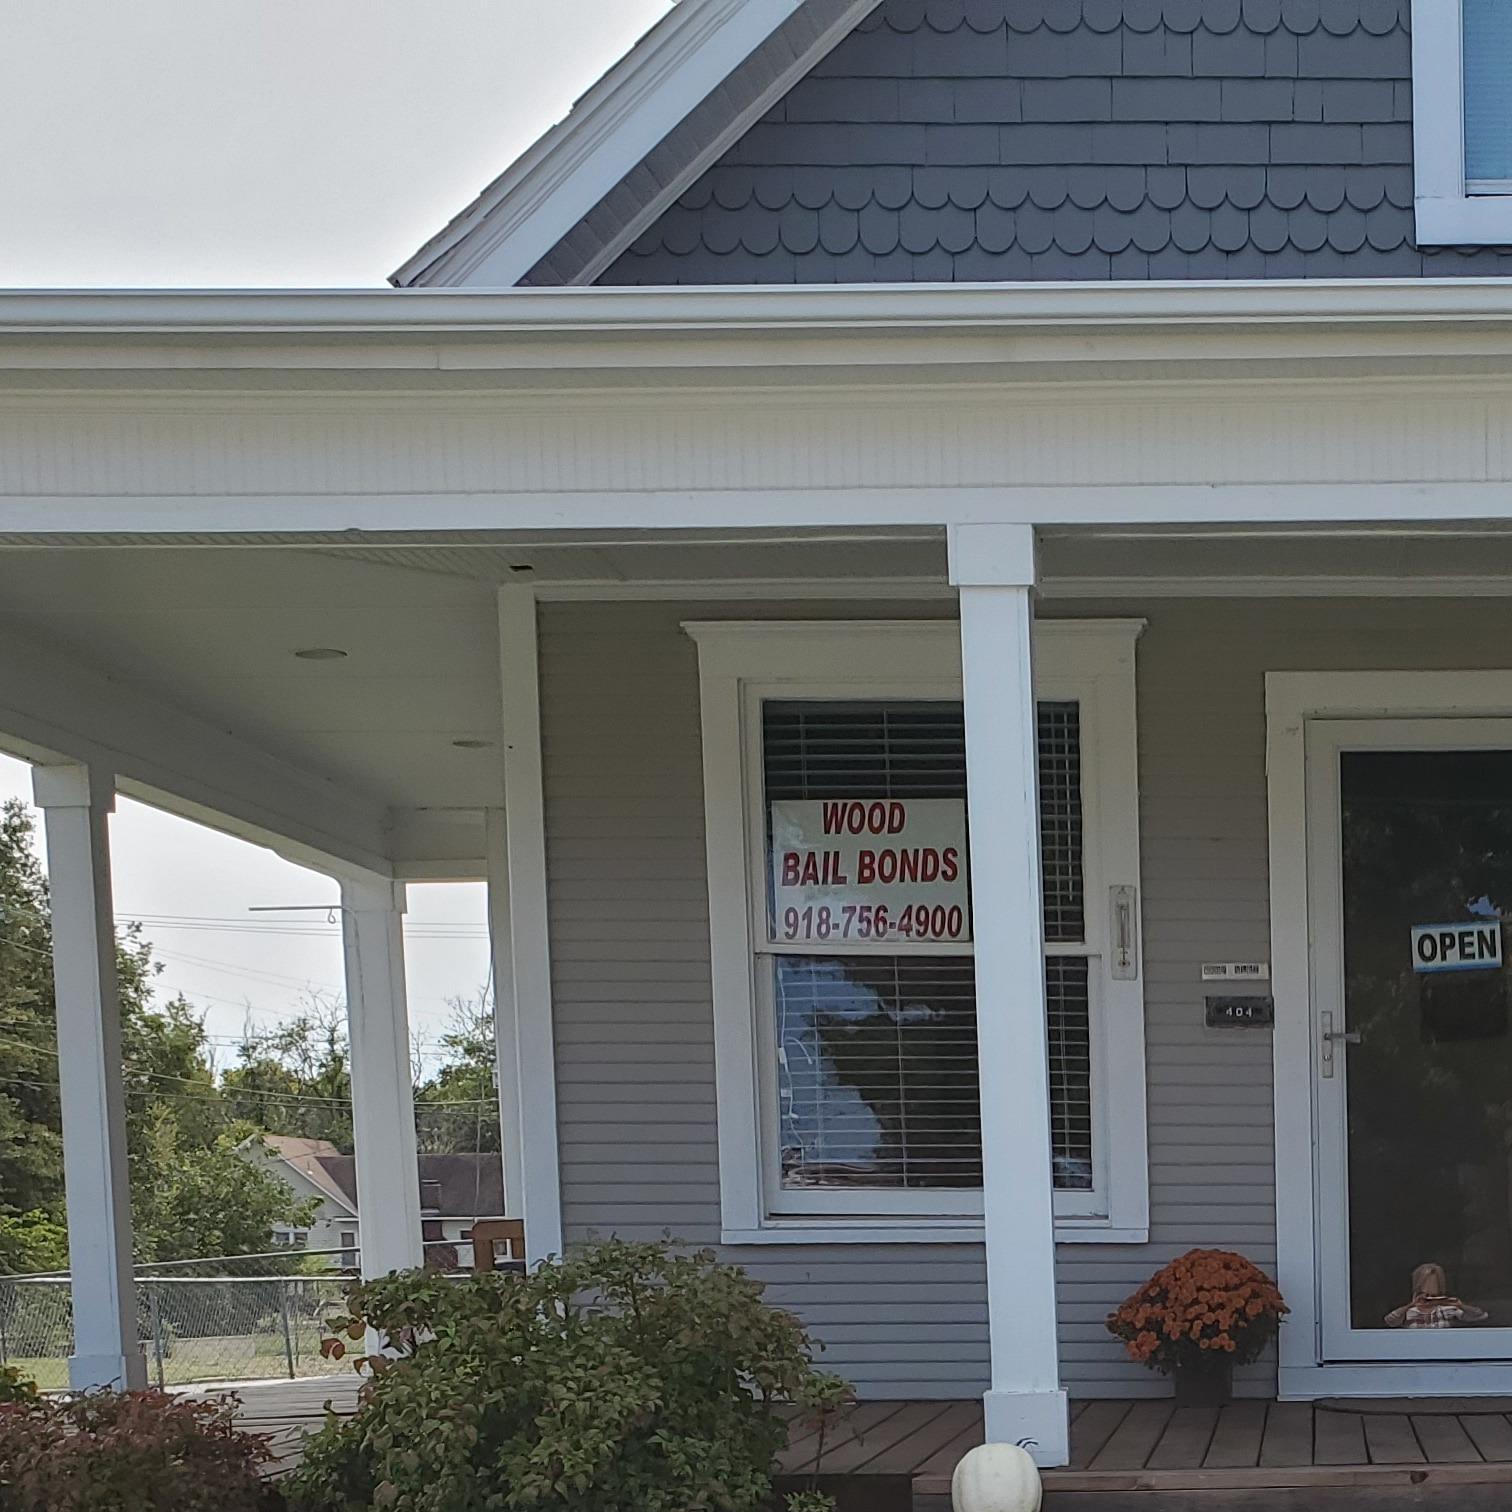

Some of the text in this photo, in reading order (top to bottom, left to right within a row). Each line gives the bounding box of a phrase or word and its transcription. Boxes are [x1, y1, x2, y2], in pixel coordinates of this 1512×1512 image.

[822, 801, 906, 835] WOOD
[781, 847, 959, 886] BAIL BONDS
[784, 904, 963, 940] 918-756-4900
[1417, 929, 1498, 963] OPEN
[1225, 1006, 1253, 1018] 404
